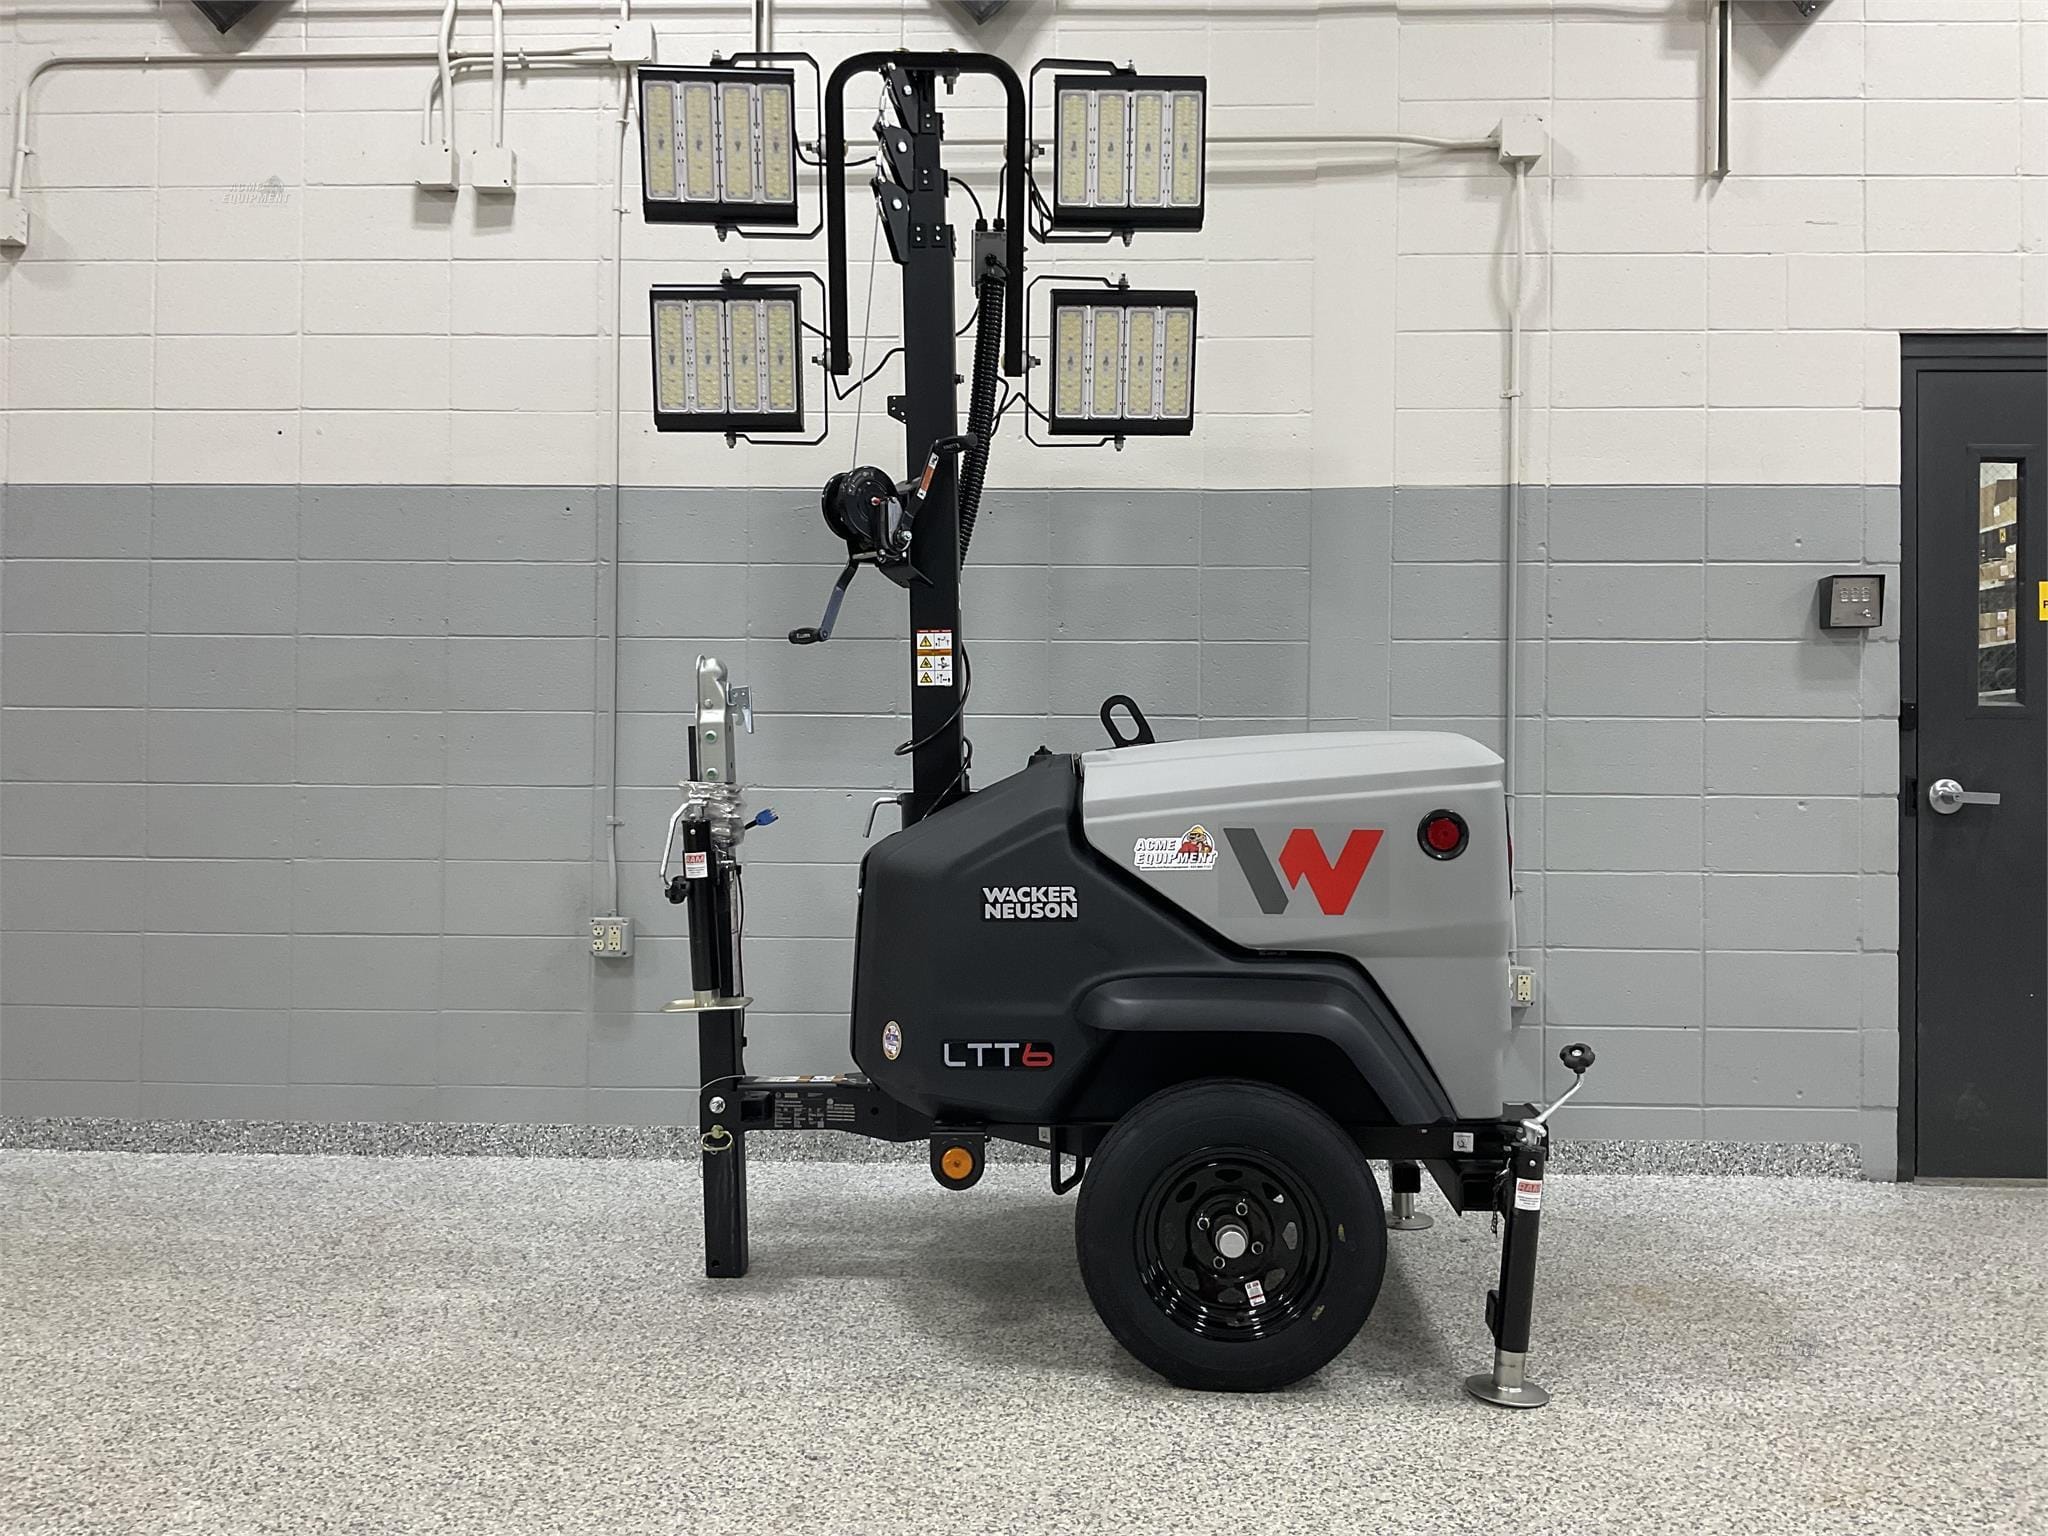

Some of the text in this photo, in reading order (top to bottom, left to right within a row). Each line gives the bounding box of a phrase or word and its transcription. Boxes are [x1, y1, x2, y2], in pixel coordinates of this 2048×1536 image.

[1136, 839, 1177, 852] ACME
[1136, 852, 1218, 865] EQUIPMENT
[982, 886, 1078, 902] WACKER
[984, 902, 1078, 919] NEUSON
[944, 1043, 1053, 1066] LTT6
